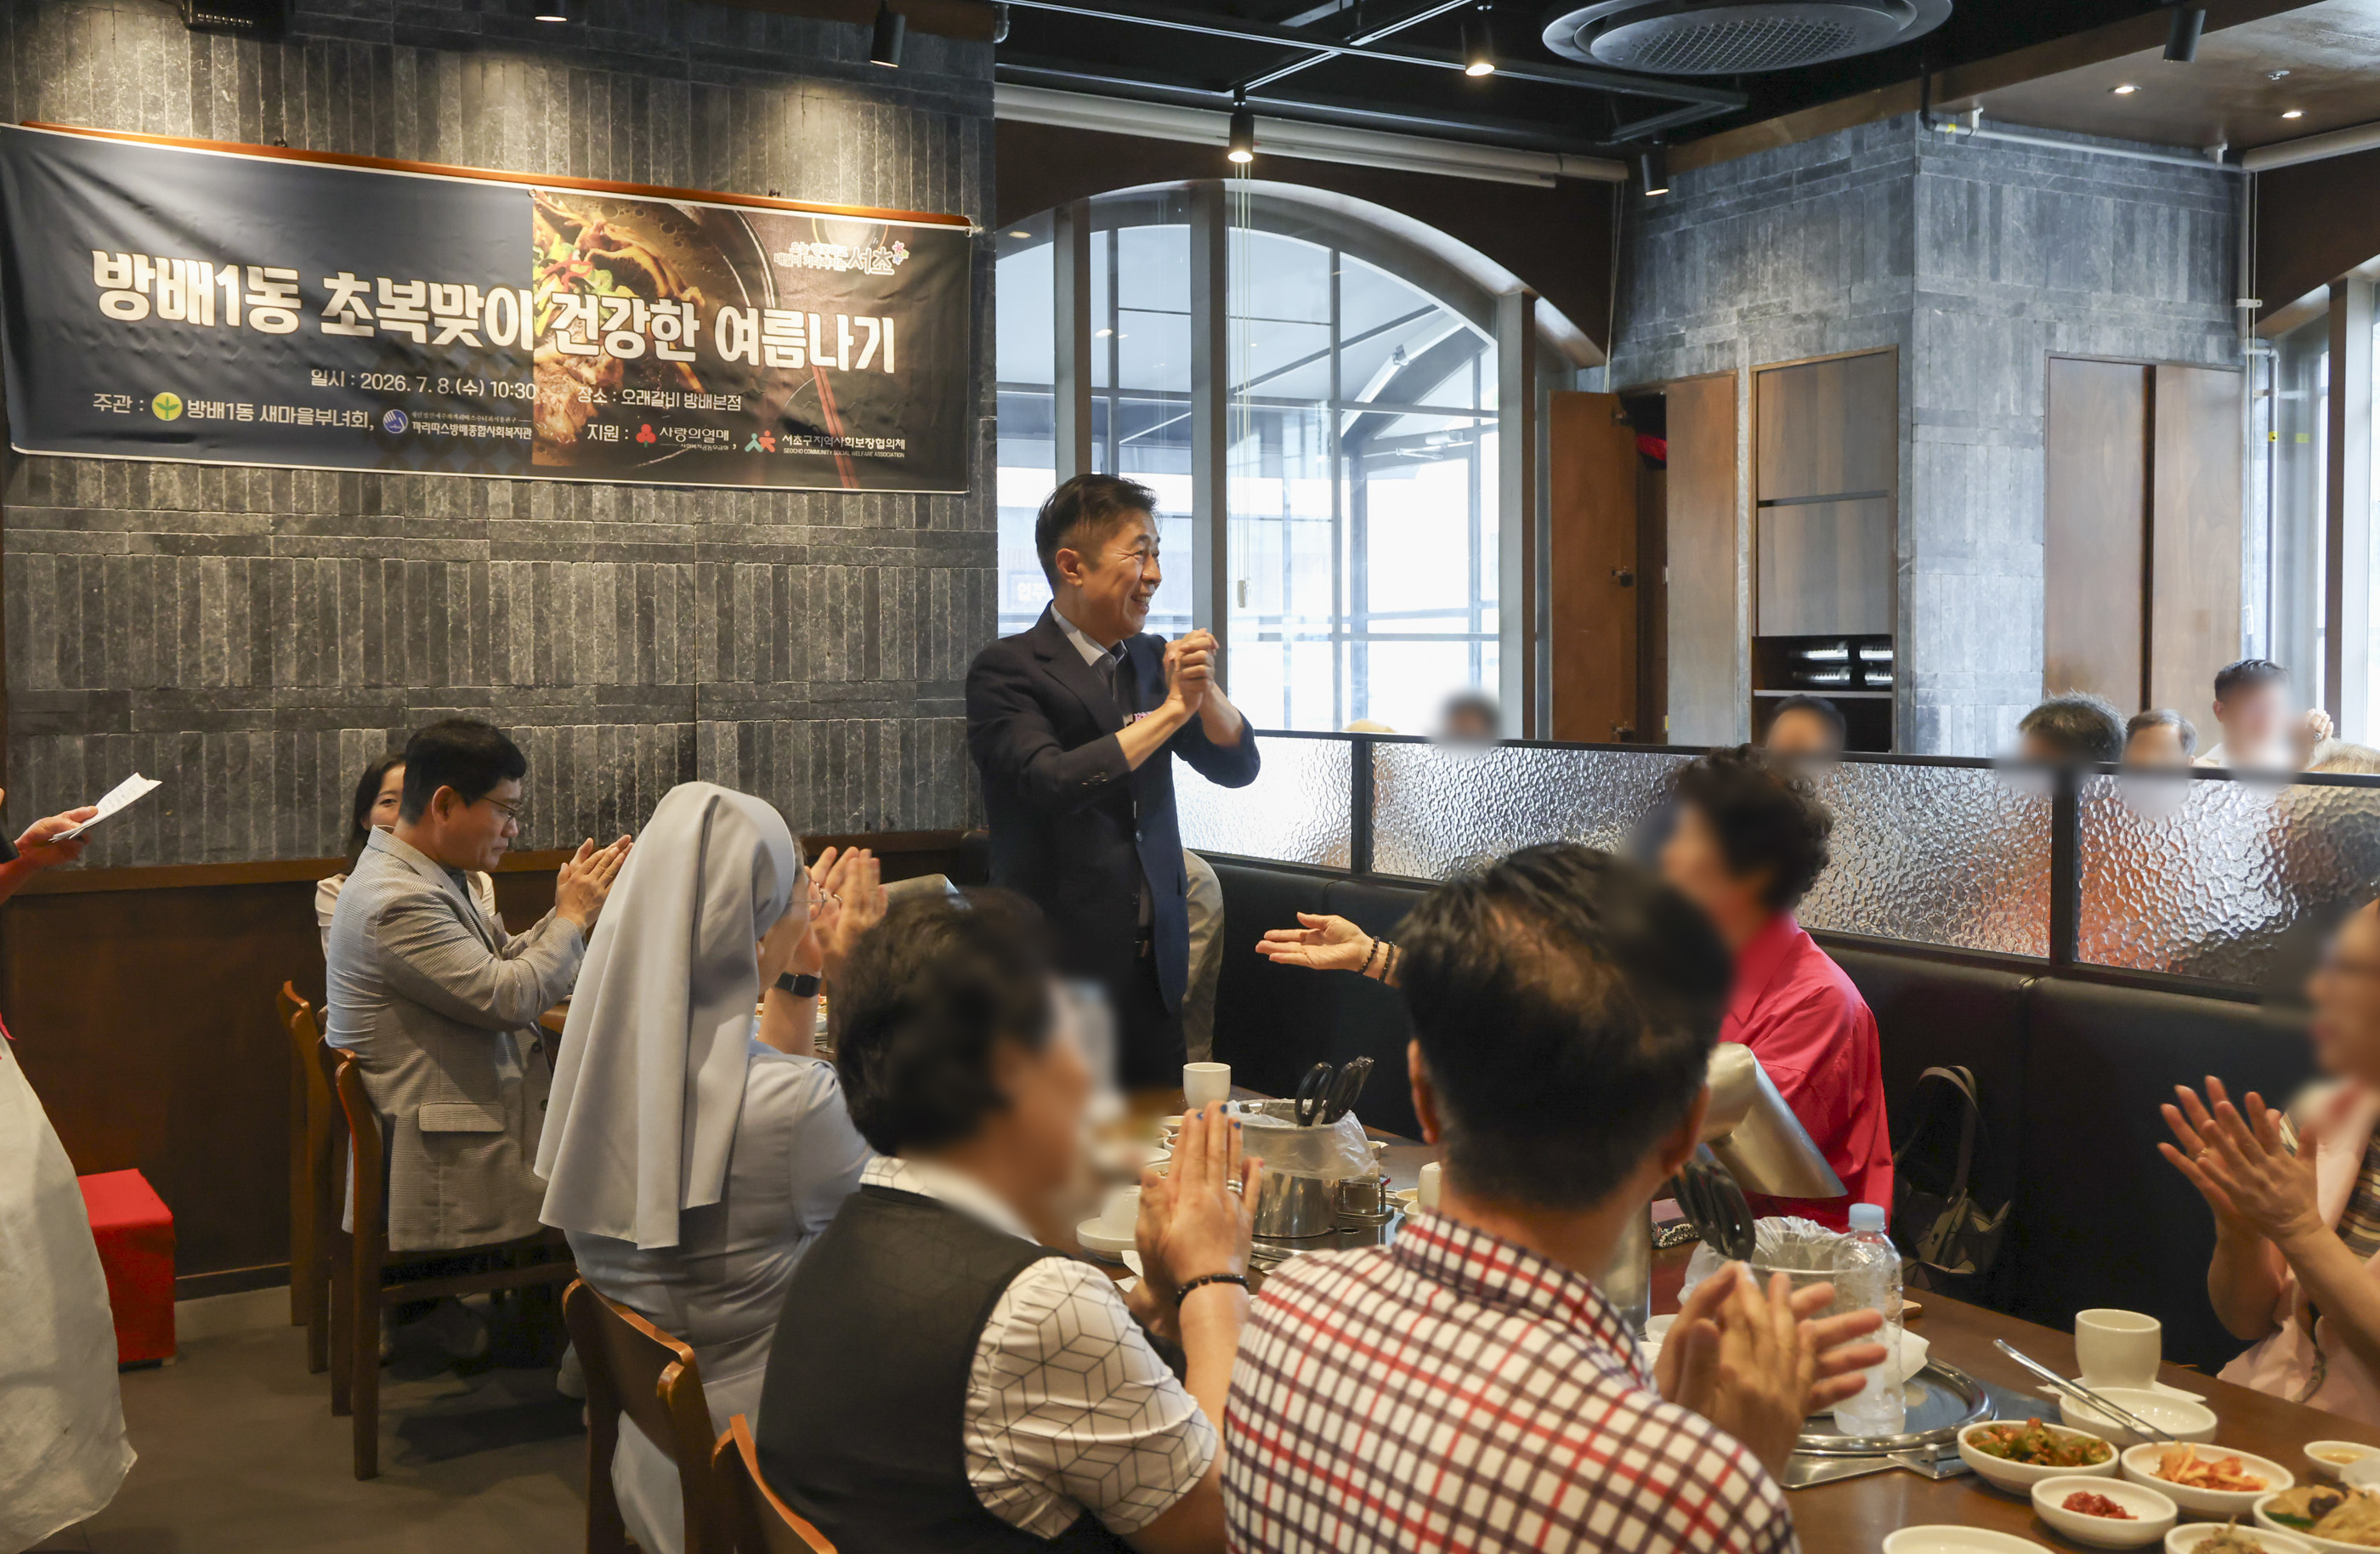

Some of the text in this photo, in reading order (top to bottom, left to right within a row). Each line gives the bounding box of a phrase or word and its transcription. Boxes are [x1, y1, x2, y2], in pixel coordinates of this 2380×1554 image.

[847, 247, 895, 275] 서초
[92, 250, 896, 374] 방배1동 초복맞이 건강한 여름나기
[310, 369, 345, 388] 일시
[360, 373, 411, 392] 2026.
[416, 376, 432, 394] 7.
[490, 381, 536, 400] 10:30
[93, 393, 133, 413] 주관
[187, 400, 254, 422] 방배1동
[578, 386, 608, 404] 장소
[621, 388, 679, 408] 오래갈비
[683, 393, 741, 411] 방배본점
[411, 421, 532, 440] 까리따스방배종합사회복지관
[587, 423, 619, 442] 지원
[659, 427, 729, 444] 사랑의열매
[781, 434, 905, 450] 서초구지역사회보장협의체
